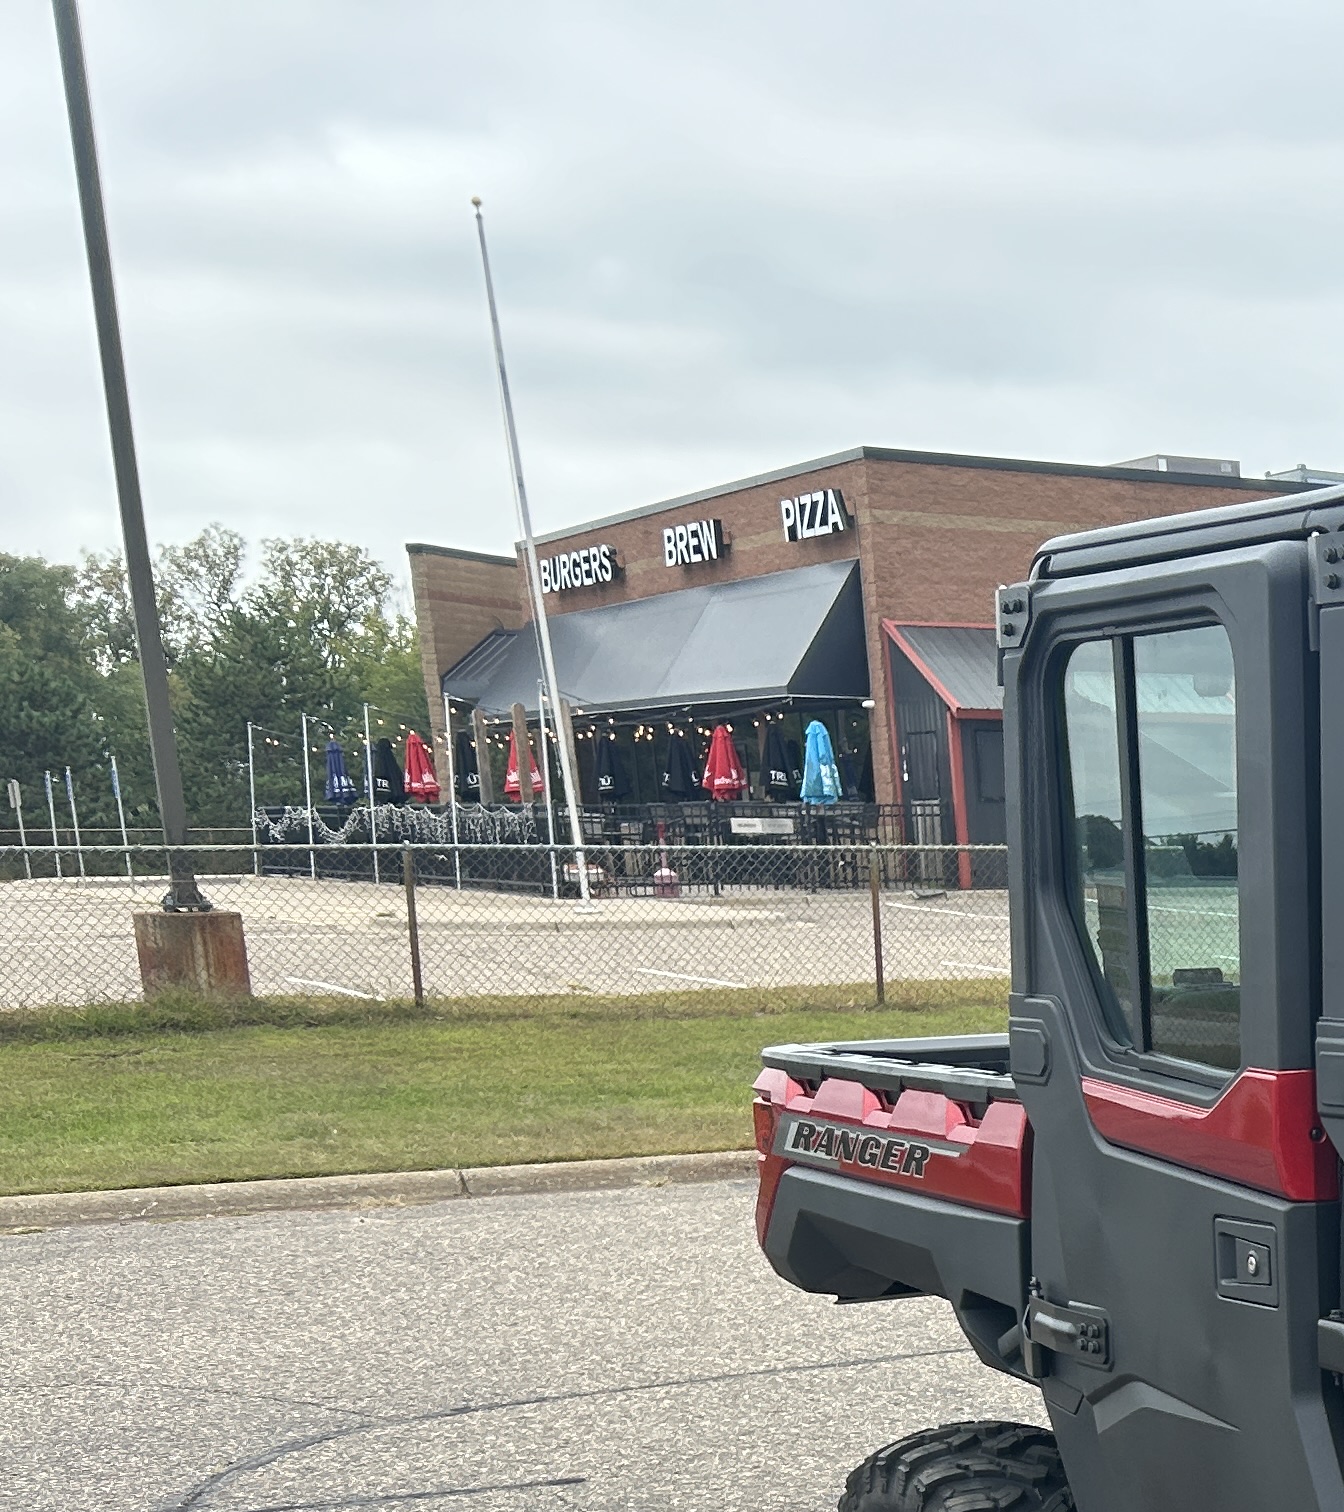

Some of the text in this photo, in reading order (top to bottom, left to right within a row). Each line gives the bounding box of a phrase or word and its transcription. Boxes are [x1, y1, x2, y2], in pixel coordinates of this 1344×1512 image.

[540, 488, 844, 594] BURGERS BREW PIZZA
[790, 1119, 931, 1179] RANGER
